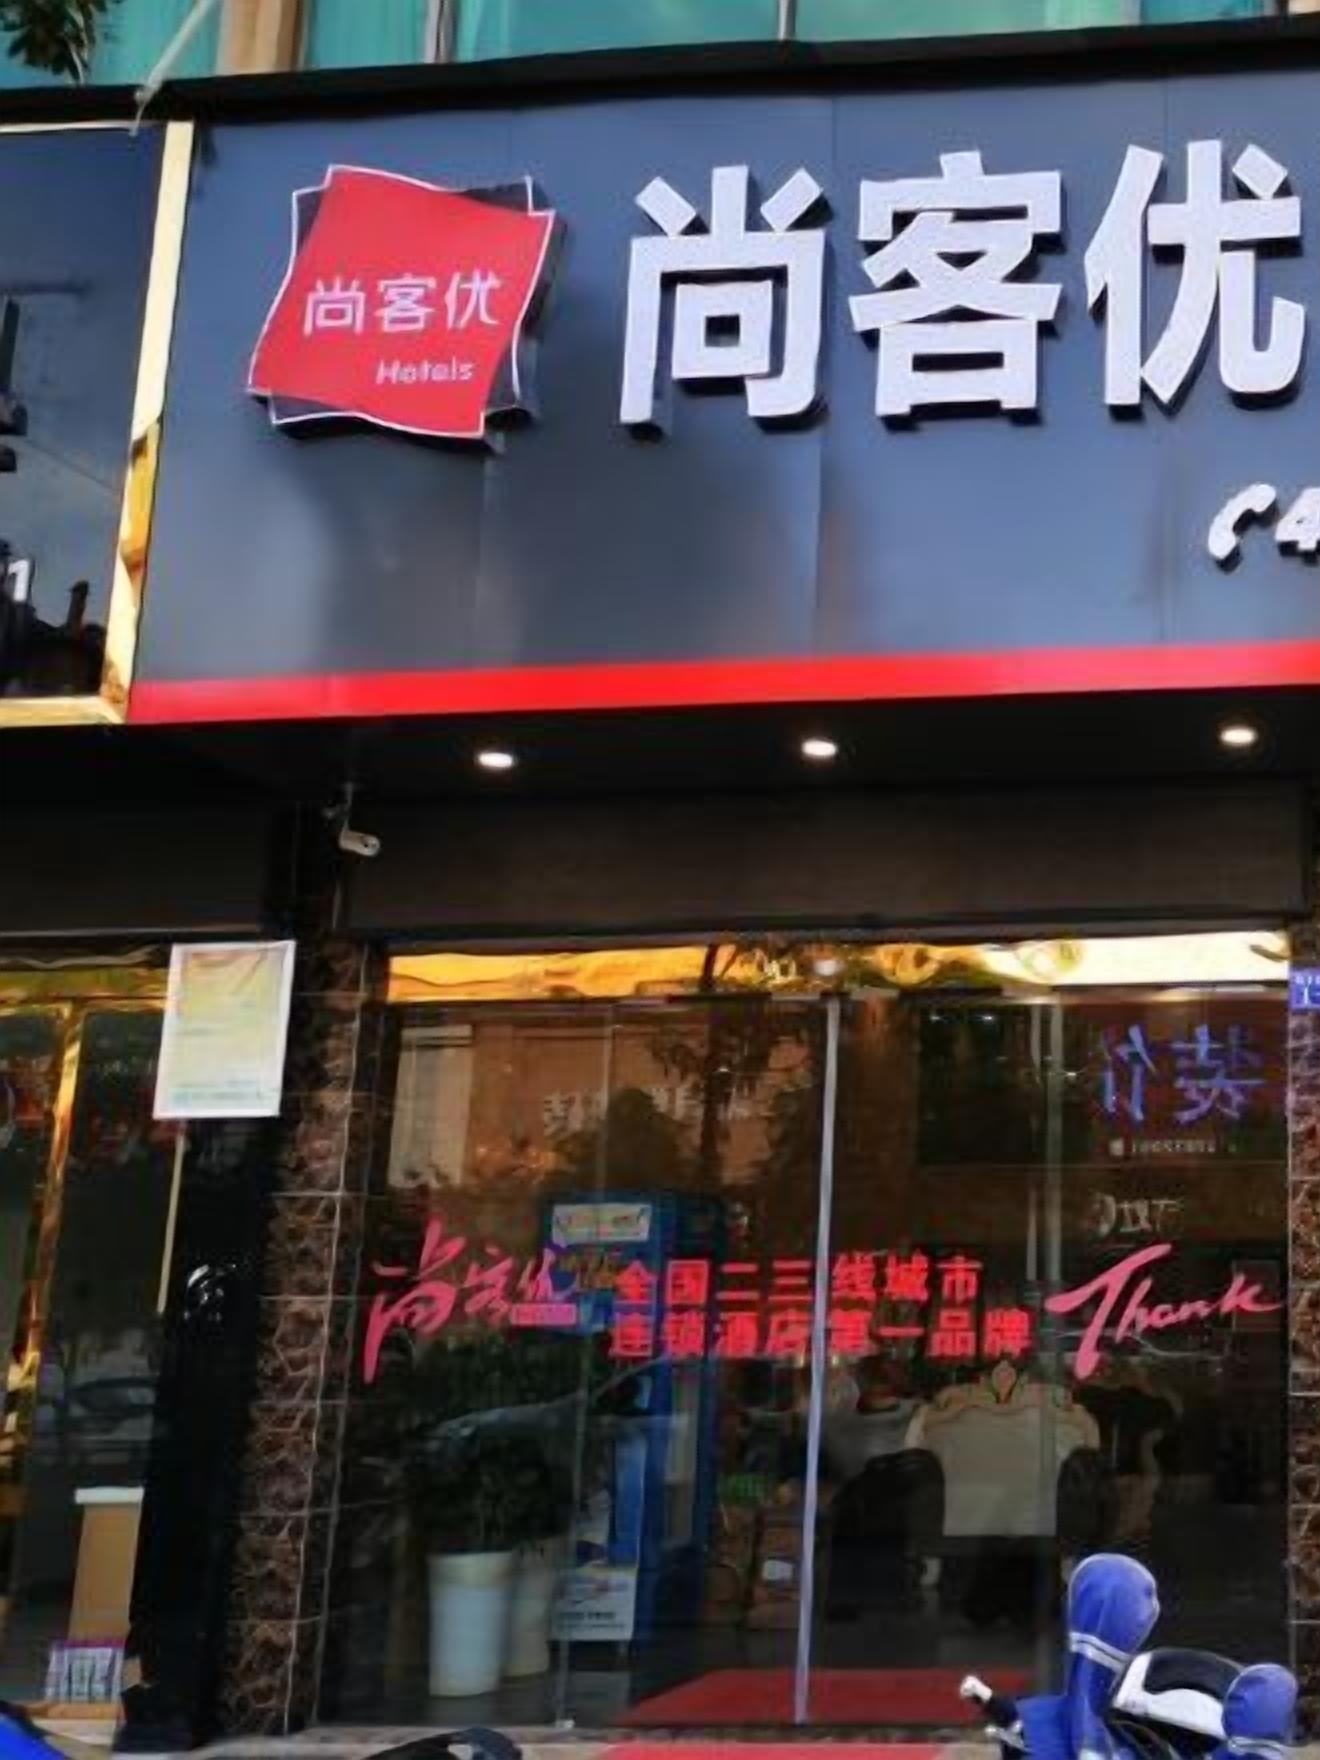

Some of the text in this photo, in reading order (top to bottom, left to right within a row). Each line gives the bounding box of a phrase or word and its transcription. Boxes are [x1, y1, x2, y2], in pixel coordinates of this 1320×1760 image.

[303, 269, 502, 336] 尚客优
[376, 357, 474, 384] Hotels
[1045, 1243, 1284, 1379] Thank
